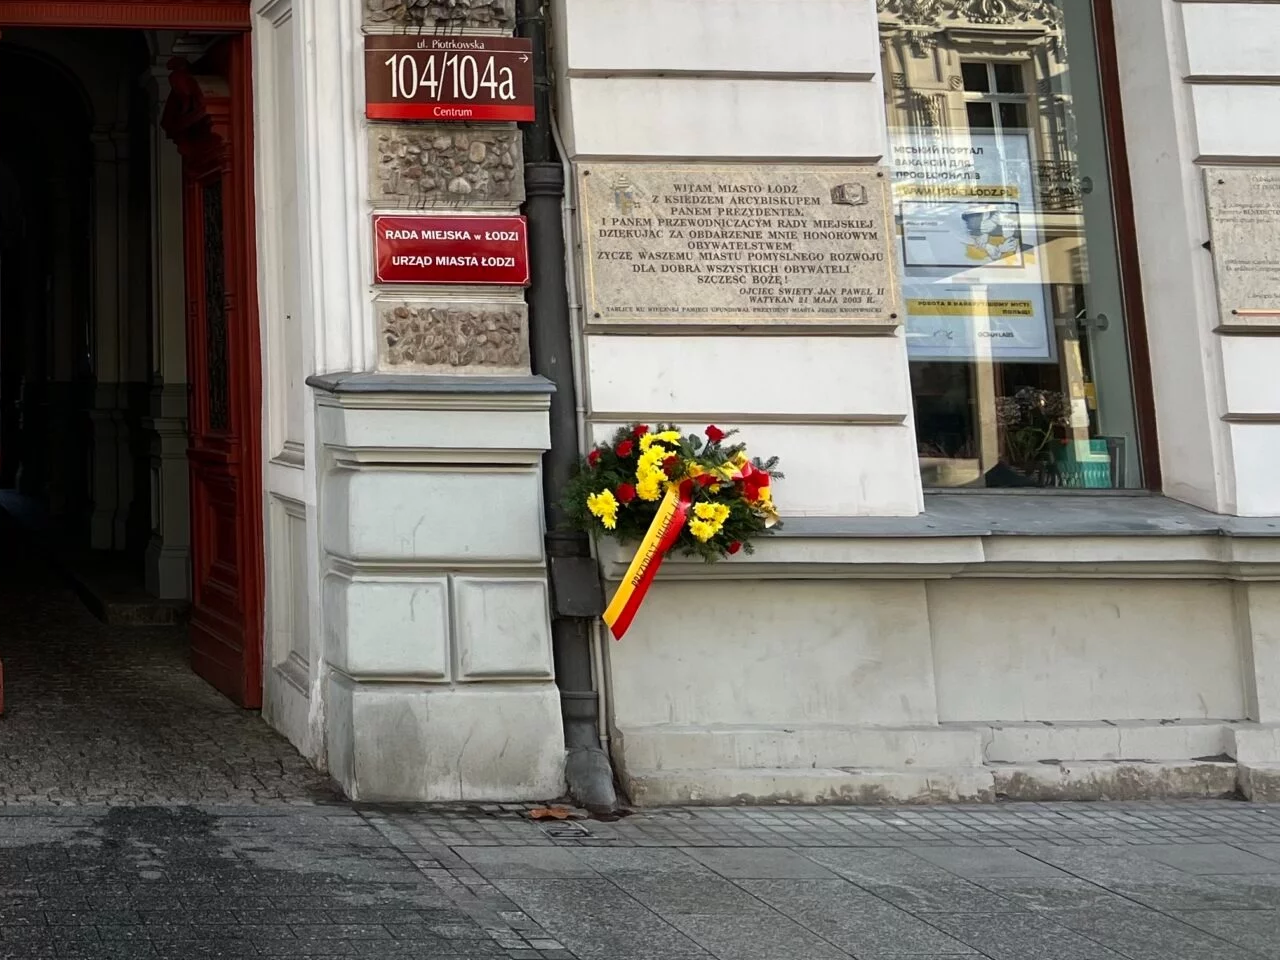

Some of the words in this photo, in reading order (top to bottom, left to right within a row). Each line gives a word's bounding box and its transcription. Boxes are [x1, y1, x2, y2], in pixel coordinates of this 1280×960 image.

[417, 40, 428, 49] ul.
[432, 39, 485, 50] Piotrkowska
[385, 52, 516, 101] 104/104a
[433, 107, 473, 117] Centrum
[673, 184, 712, 193] WITAM
[718, 184, 762, 193] MIASTO
[652, 195, 659, 204] Z
[729, 196, 821, 206] ARCYBISKUPEM
[671, 207, 712, 216] PANEM
[718, 207, 804, 217] PREZYDENTEM
[612, 218, 652, 226] PANEM
[777, 219, 808, 228] RADY
[813, 220, 874, 229] MIEJSKIEJ
[385, 231, 419, 240] RADA
[421, 231, 471, 241] MIEJSKA
[485, 231, 520, 241] ŁODZI
[669, 230, 683, 239] ZA
[689, 230, 763, 239] OBDARZENIE
[768, 231, 798, 240] MNIE
[803, 231, 878, 240] HONOROWYM
[687, 241, 793, 251] OBYWATELSTWEM
[638, 251, 693, 261] WASZEMU
[699, 252, 742, 261] MIASTU
[830, 252, 884, 261] ROZWOJU
[392, 256, 433, 268] URZĄD
[436, 257, 479, 267] MIASTA
[481, 257, 515, 268] ŁODZI
[632, 264, 656, 273] DLA
[661, 264, 701, 273] DOBRA
[706, 264, 778, 274] WSZYSTKICH
[739, 287, 774, 295] OJCIEC
[818, 287, 837, 296] JAN
[877, 287, 884, 296] II
[749, 296, 794, 304] WATYKAN
[813, 296, 838, 304] MAJA
